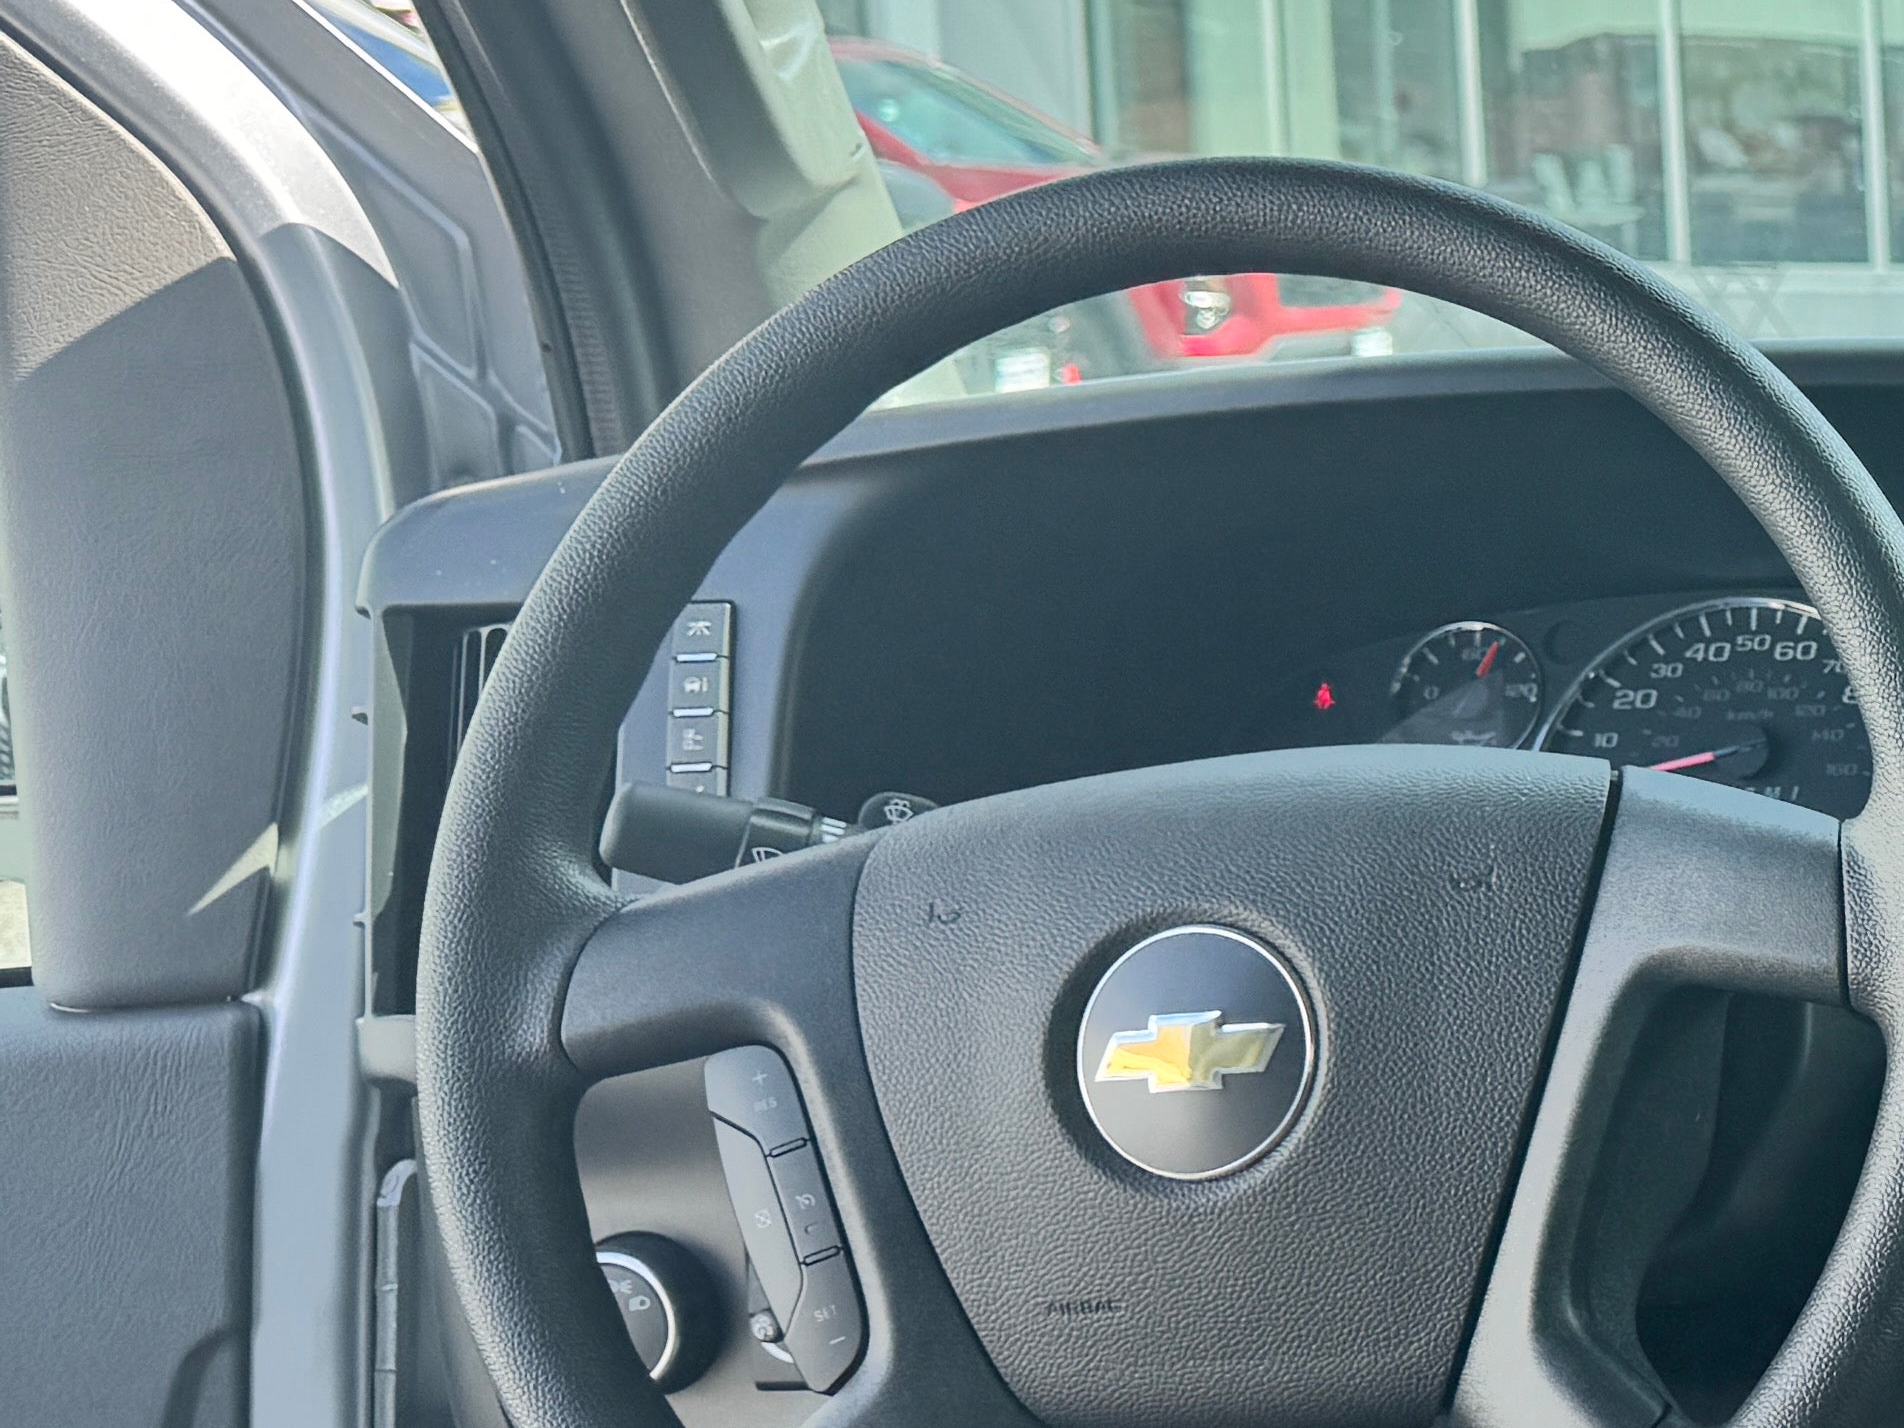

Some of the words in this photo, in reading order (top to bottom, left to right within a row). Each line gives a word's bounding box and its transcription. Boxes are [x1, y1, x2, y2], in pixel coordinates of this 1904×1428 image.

[1735, 634, 1772, 651] 50
[1773, 641, 1818, 661] 60
[1684, 642, 1732, 662] 40
[1650, 662, 1684, 679] 30
[1612, 689, 1658, 710] 20
[1594, 732, 1618, 748] 10
[813, 1305, 838, 1323] SET
